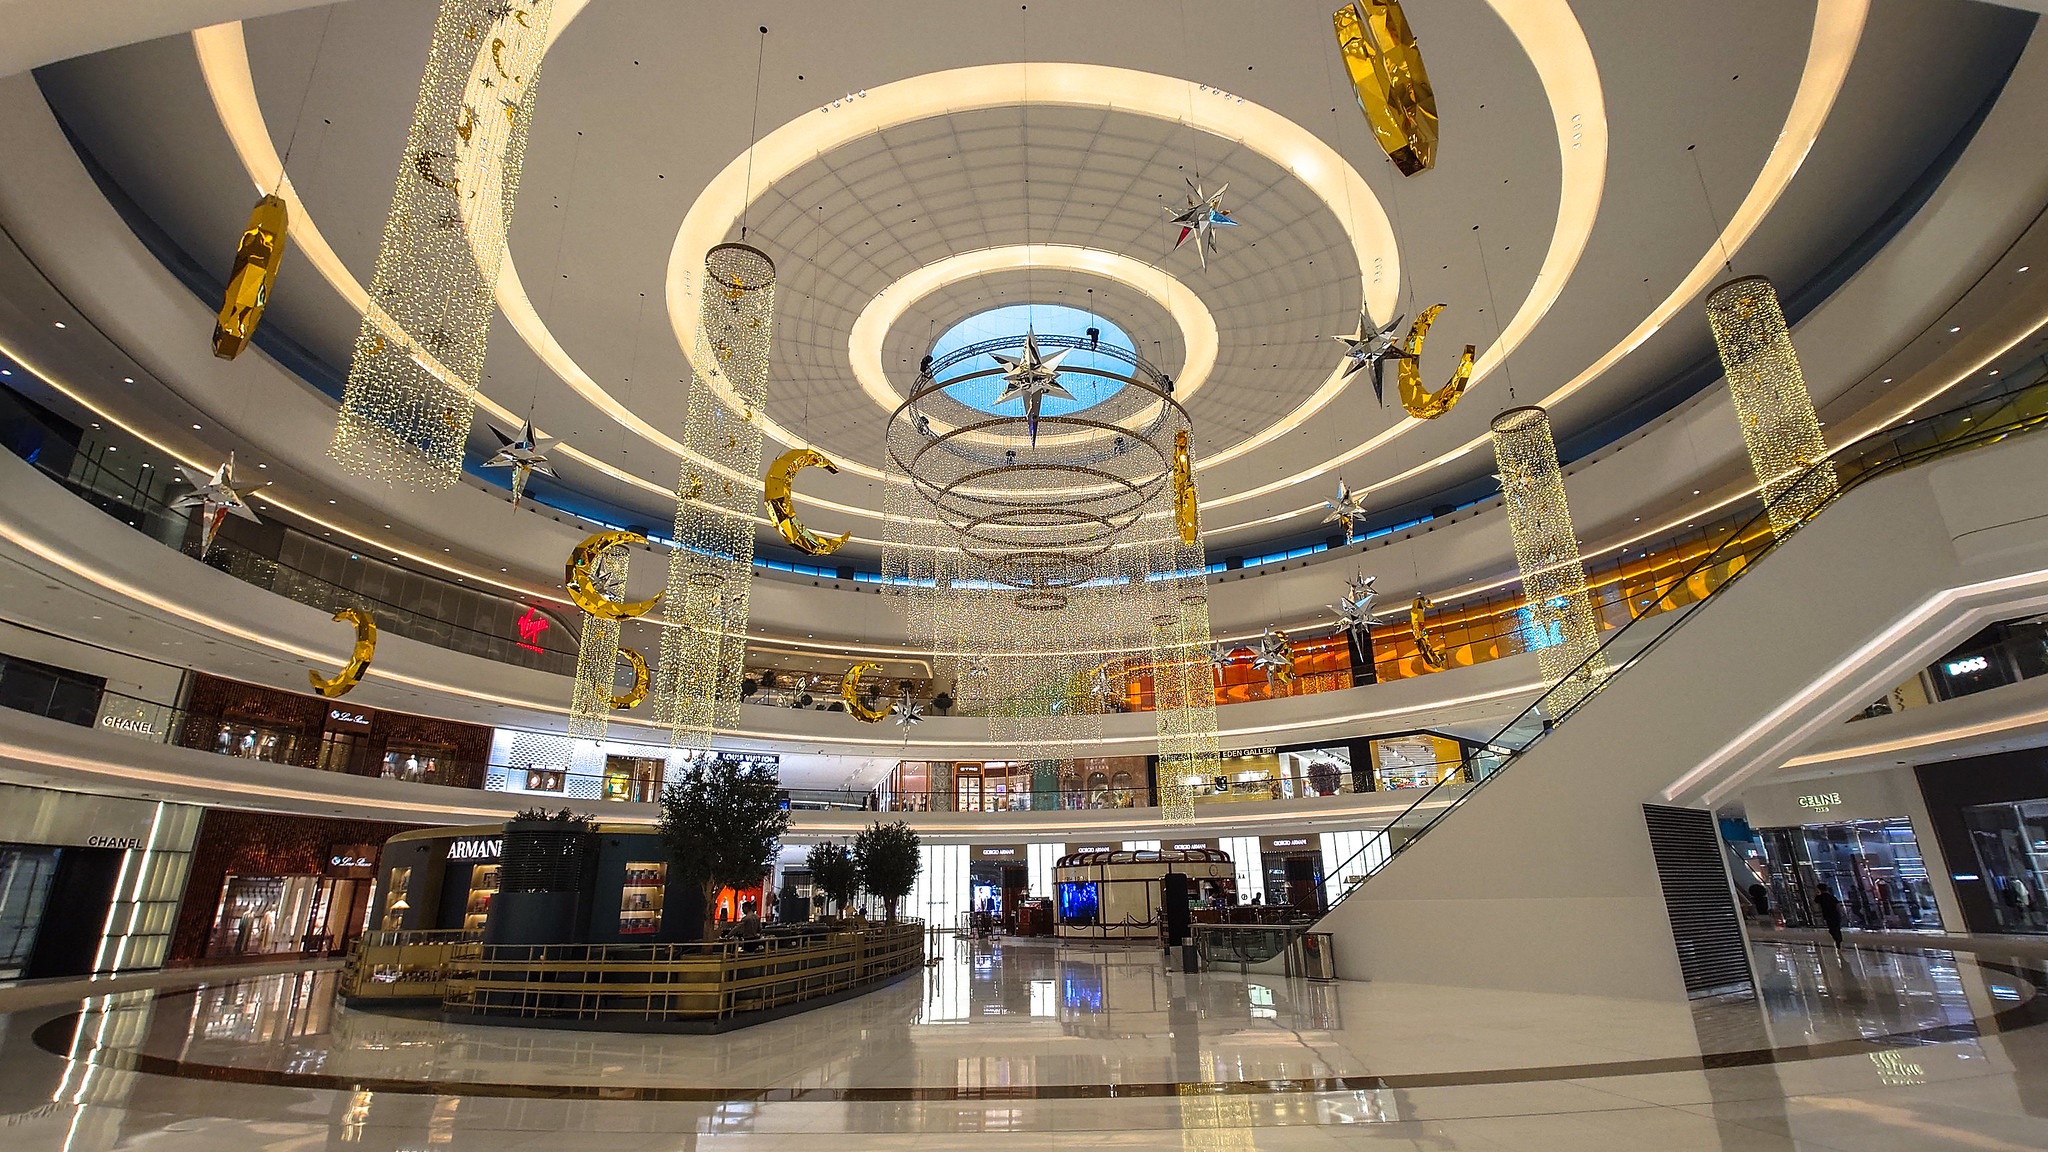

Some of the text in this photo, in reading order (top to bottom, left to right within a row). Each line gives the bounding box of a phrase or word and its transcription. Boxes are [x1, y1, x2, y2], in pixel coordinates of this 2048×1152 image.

[517, 607, 549, 644] Virgin
[1947, 656, 1988, 675] BOSS
[102, 716, 155, 735] CHANEL
[1222, 746, 1277, 758] EDEN GALLERY
[1798, 792, 1842, 808] CELINE
[88, 835, 143, 849] CHANEL
